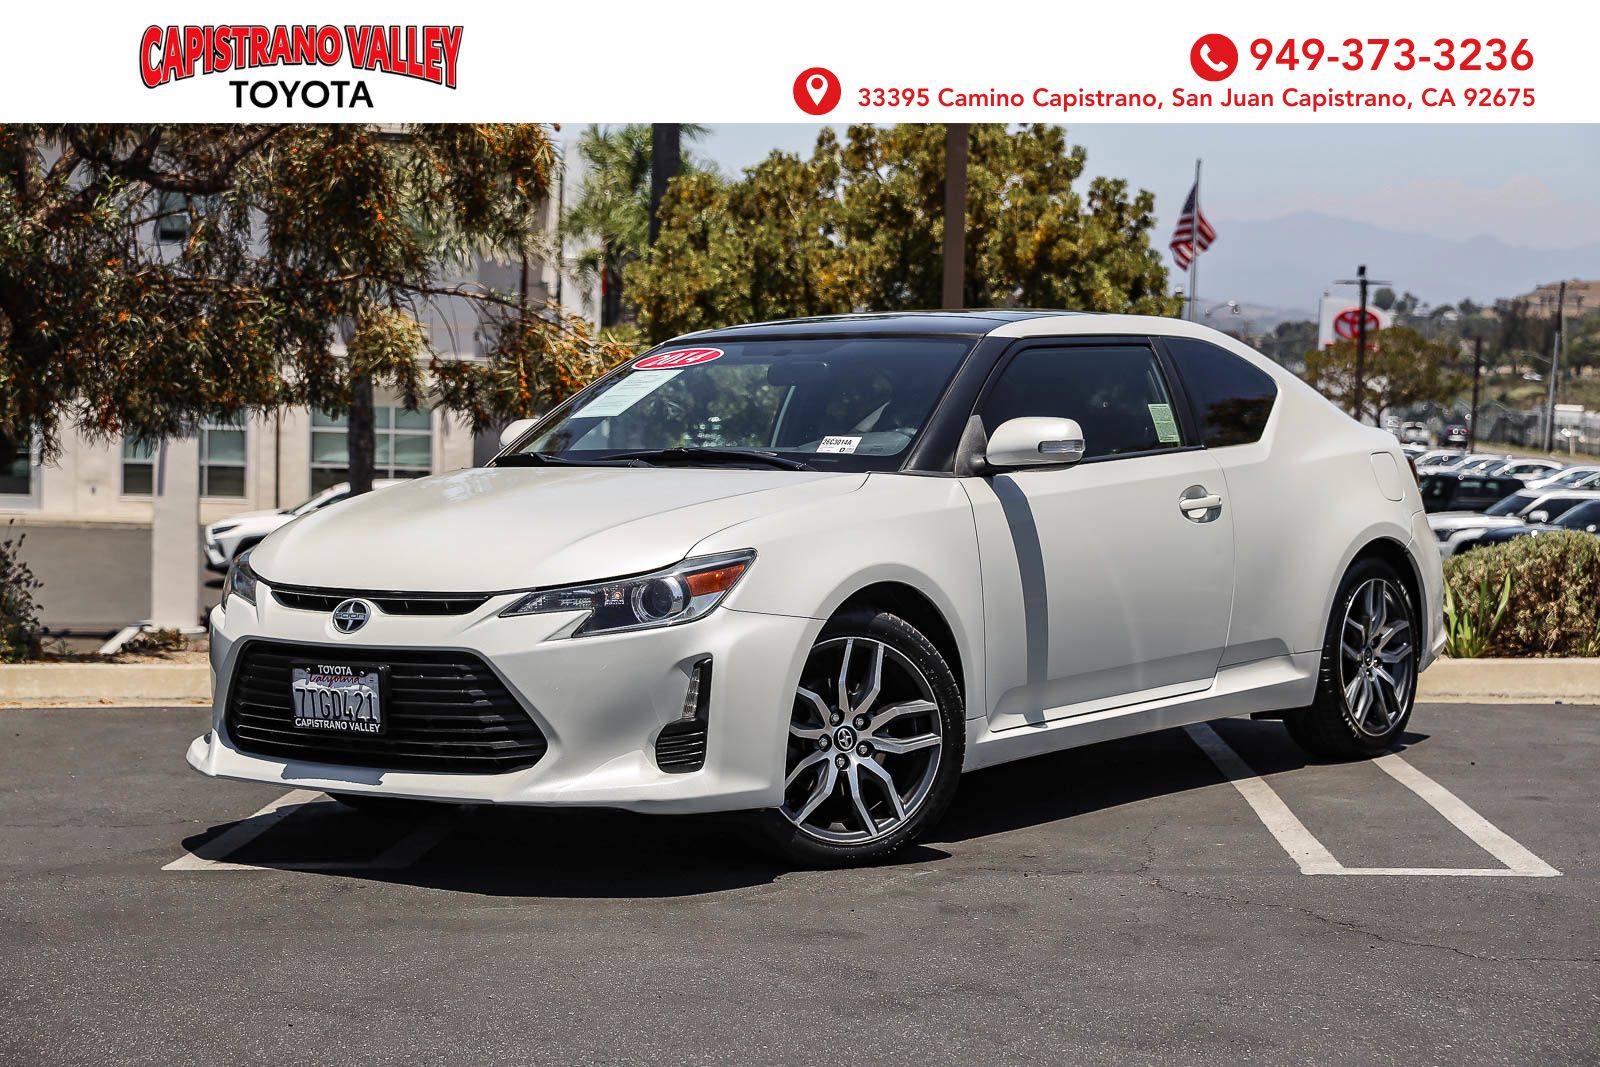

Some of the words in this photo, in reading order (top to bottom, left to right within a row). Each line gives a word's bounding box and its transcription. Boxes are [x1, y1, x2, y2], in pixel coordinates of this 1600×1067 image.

[641, 350, 717, 367] 2014
[318, 664, 353, 676] TOYOTA
[295, 688, 378, 722] 7TGD421
[295, 718, 348, 730] CAPISTRANO
[348, 721, 380, 733] VALLEY
